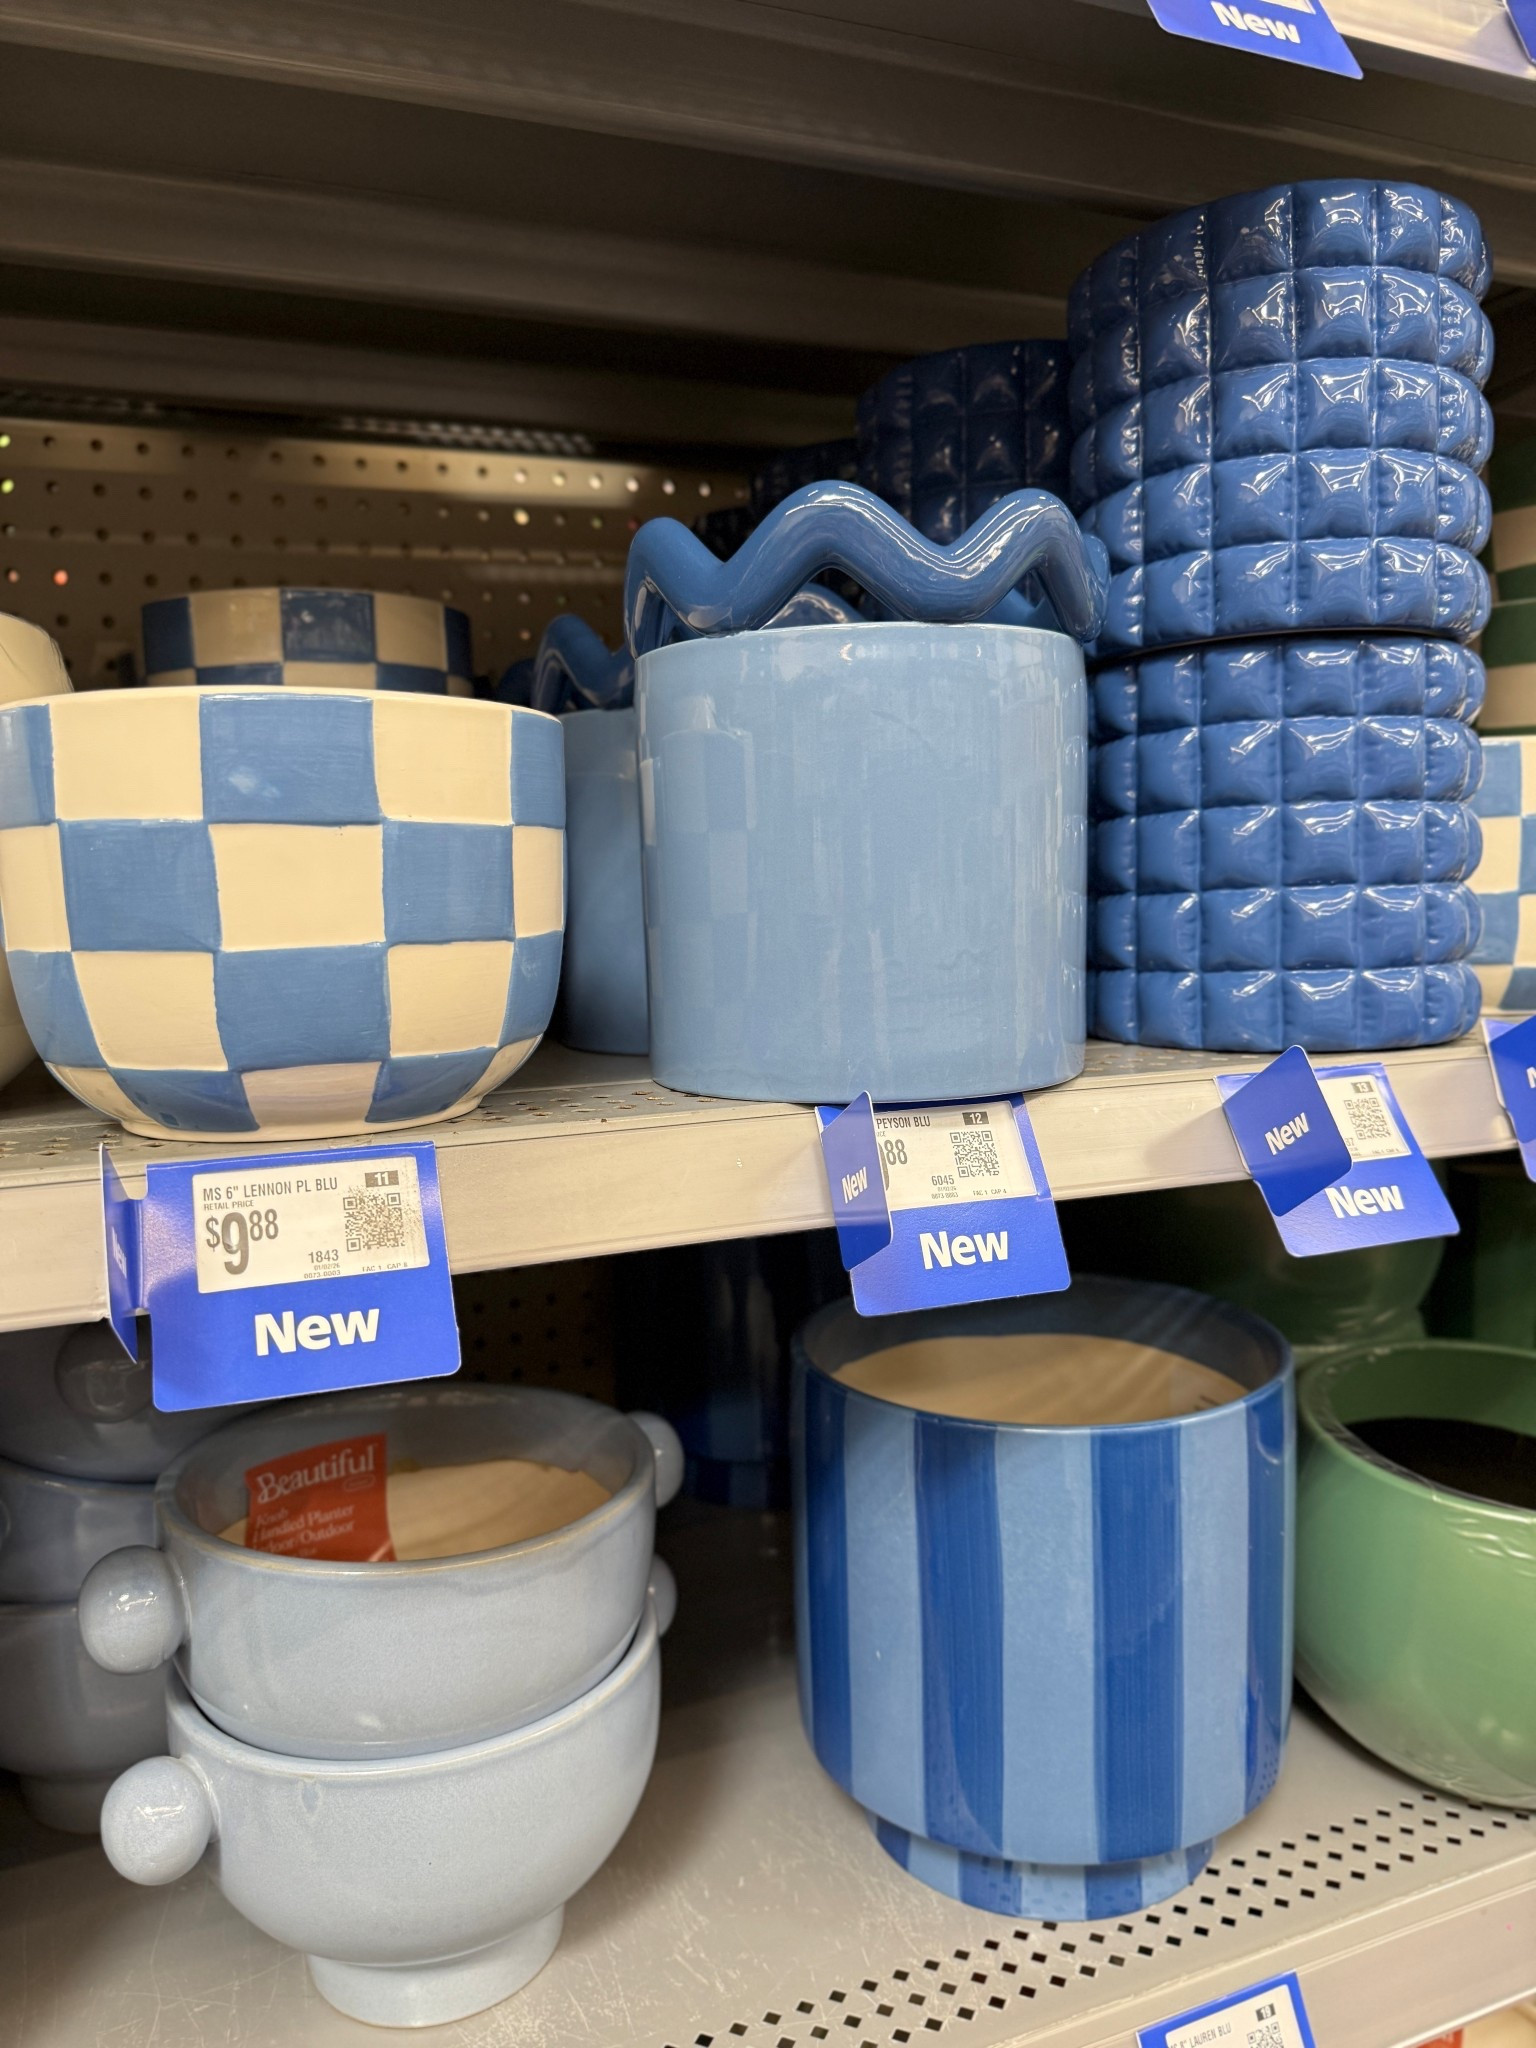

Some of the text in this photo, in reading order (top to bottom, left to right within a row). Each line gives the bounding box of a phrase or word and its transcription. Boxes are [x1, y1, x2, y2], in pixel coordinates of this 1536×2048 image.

[1210, 0, 1301, 44] New
[1357, 1082, 1370, 1093] 13
[876, 1115, 931, 1129] PEYSON BLU
[970, 1112, 983, 1124] 12
[1264, 1111, 1310, 1156] New
[203, 1176, 338, 1201] MS 6" LENNON PL BLU
[374, 1171, 389, 1186] 11
[841, 1166, 868, 1204] New
[931, 1174, 955, 1186] 6045
[203, 1199, 255, 1212] RETAIL PRICE
[1325, 1185, 1405, 1218] New
[308, 1248, 340, 1264] 1843
[919, 1230, 1009, 1269] New
[254, 1308, 380, 1357] New
[256, 1443, 376, 1505] Beautiful
[307, 1504, 355, 1527] Planter
[1260, 2005, 1272, 2019] 19
[1189, 2027, 1217, 2048] LAUREN
[1218, 2022, 1232, 2037] BLU
